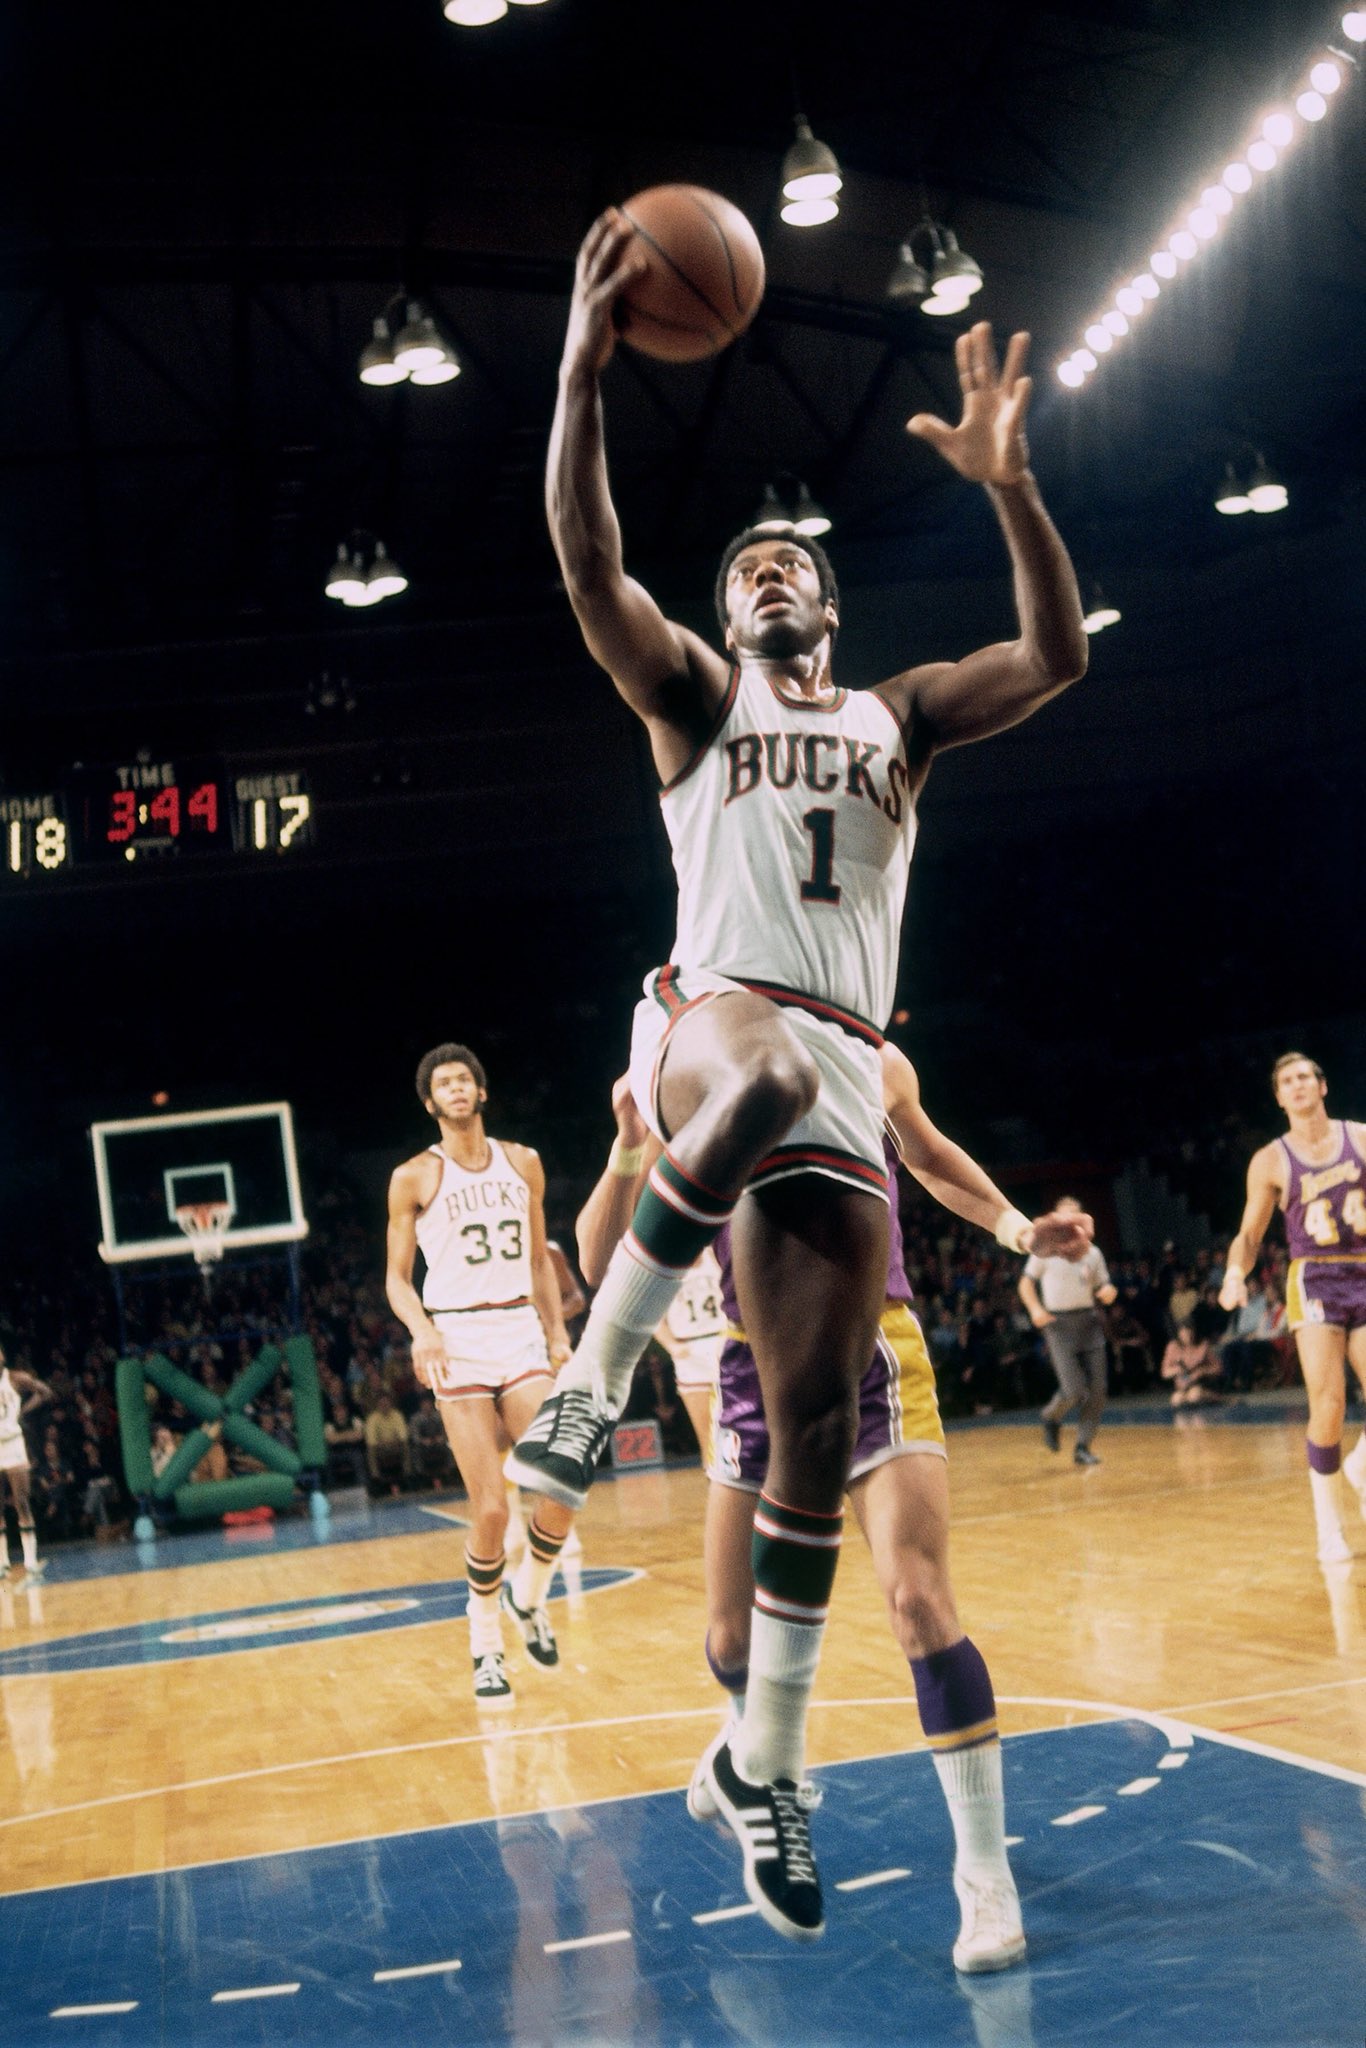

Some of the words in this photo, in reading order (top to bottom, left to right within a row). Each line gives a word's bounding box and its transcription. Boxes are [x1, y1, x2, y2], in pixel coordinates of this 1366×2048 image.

[117, 763, 174, 788] TIME
[724, 733, 906, 825] BUCKS
[107, 783, 217, 842] 3:44
[254, 795, 309, 849] 17
[7, 817, 66, 872] 18
[800, 807, 841, 906] 1
[445, 1182, 527, 1221] BUCKS
[1304, 1189, 1366, 1246] 44
[461, 1219, 523, 1266] 33
[686, 1295, 718, 1322] 14
